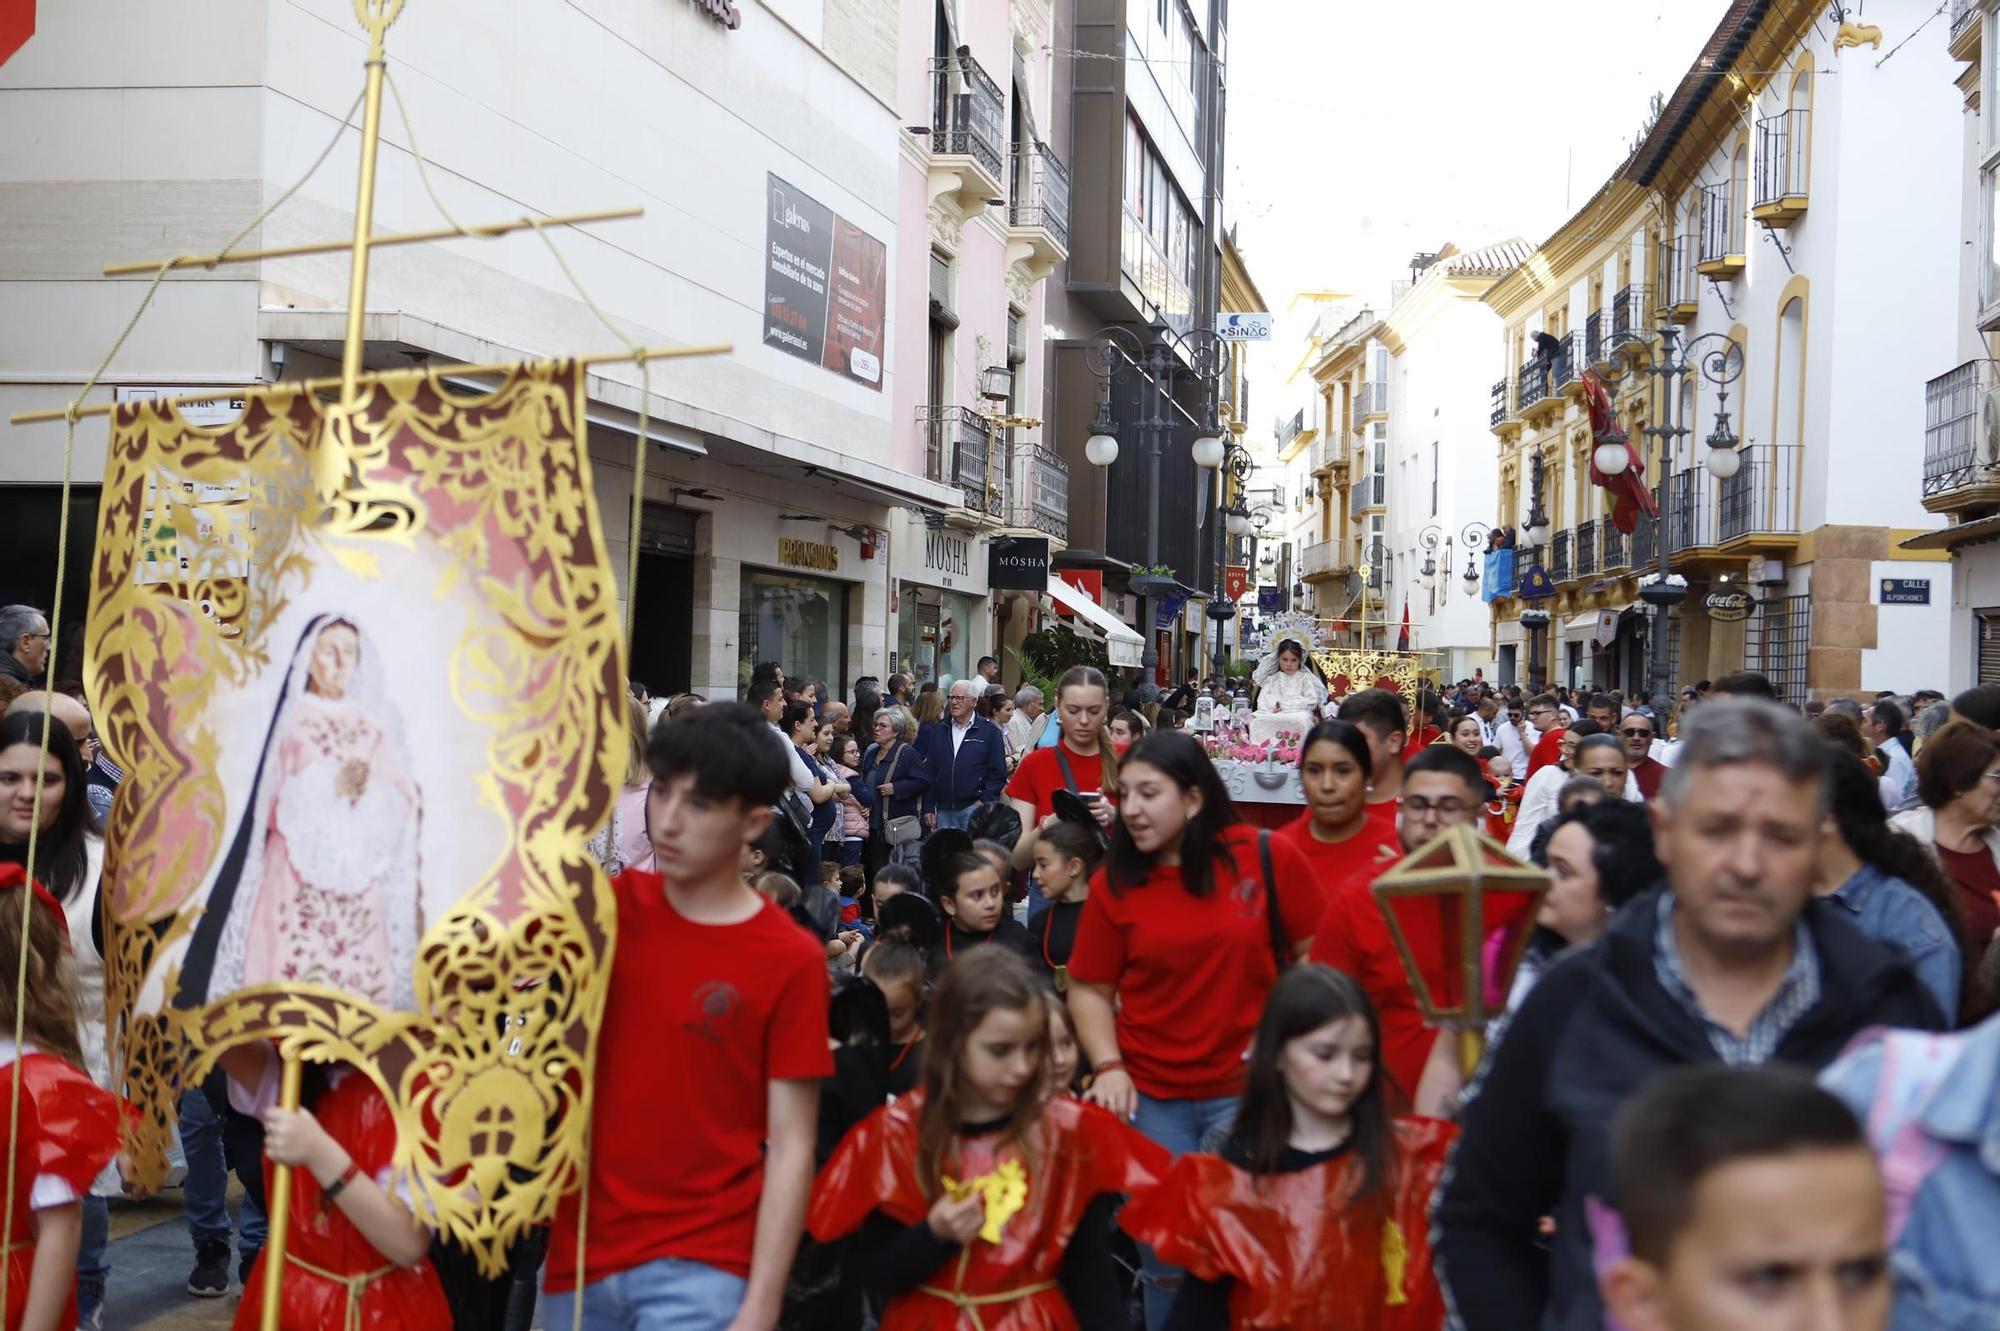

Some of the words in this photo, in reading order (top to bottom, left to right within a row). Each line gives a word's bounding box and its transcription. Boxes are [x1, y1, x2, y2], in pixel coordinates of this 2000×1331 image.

[772, 241, 794, 263] Expertos
[794, 255, 800, 267] en
[801, 257, 806, 269] el
[806, 262, 825, 280] mercado
[772, 256, 800, 282] inmobiliario
[800, 272, 806, 286] de
[807, 276, 812, 289] tu
[812, 280, 824, 294] zona
[999, 555, 1045, 568] MÖSHA
[1903, 580, 1927, 589] CALLE
